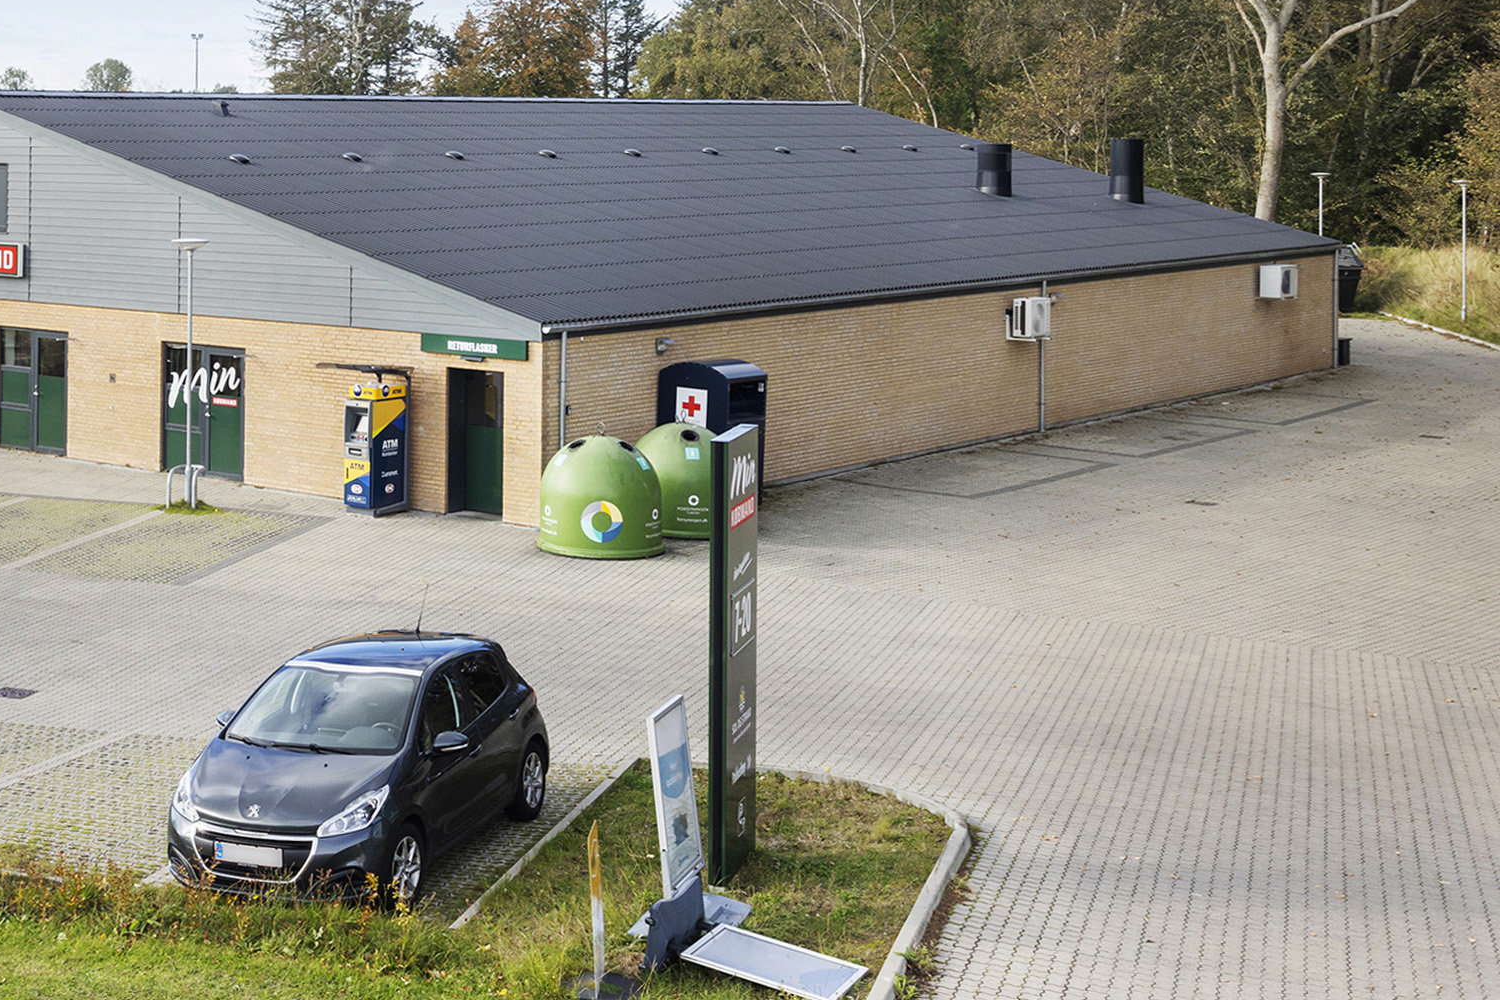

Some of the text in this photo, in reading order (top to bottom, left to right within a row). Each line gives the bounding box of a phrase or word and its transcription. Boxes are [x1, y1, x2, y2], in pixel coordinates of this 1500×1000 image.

[447, 340, 498, 354] RETURFLASKER
[168, 362, 240, 409] Min
[382, 439, 398, 450] ATM
[730, 453, 756, 500] Min
